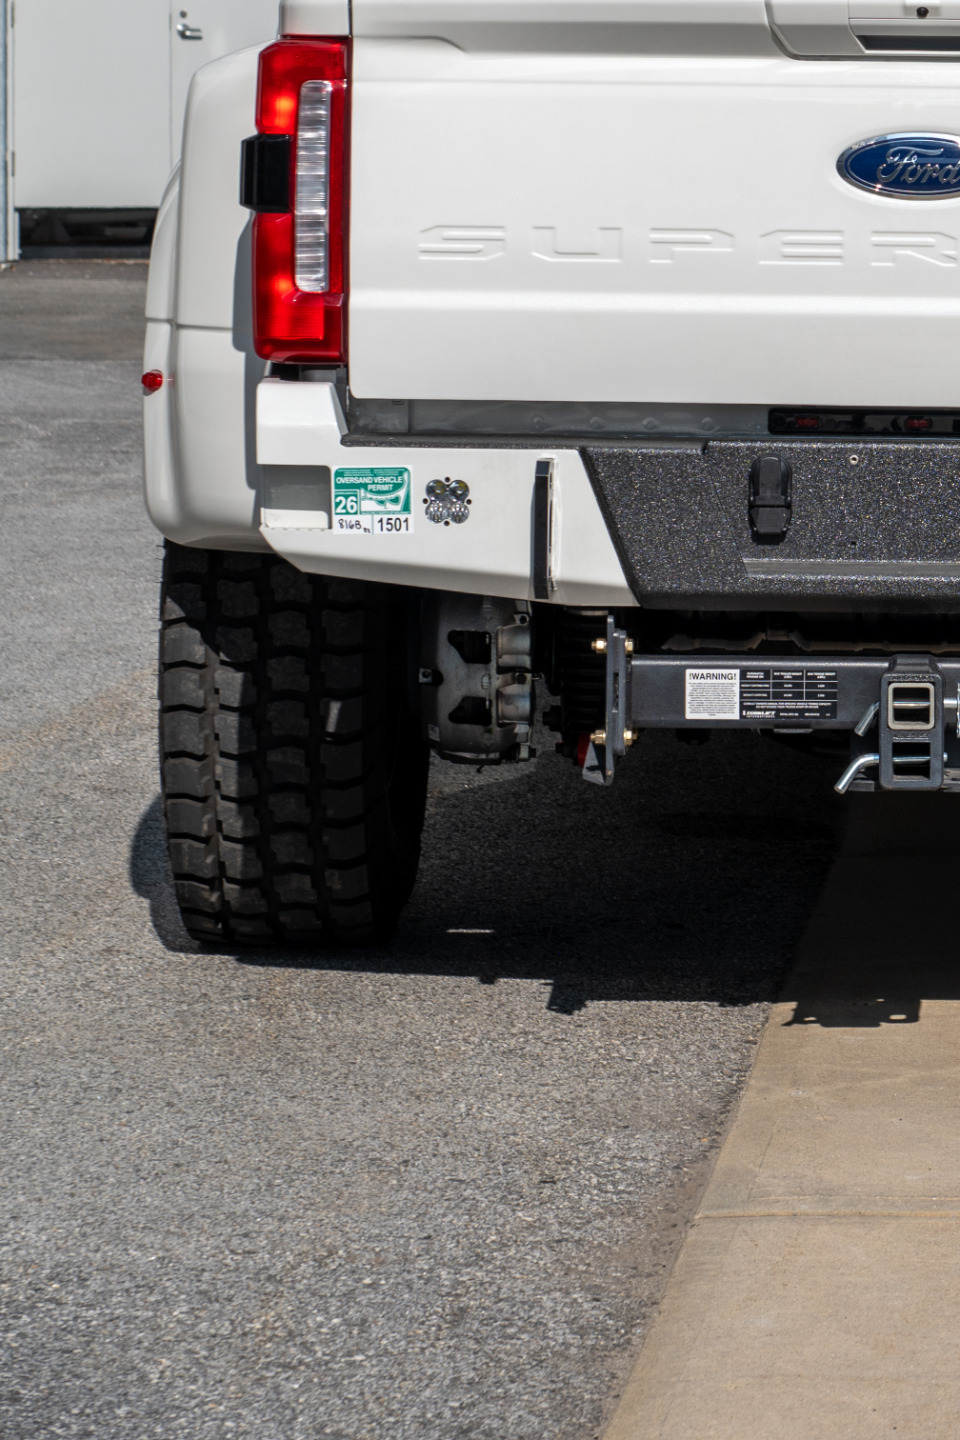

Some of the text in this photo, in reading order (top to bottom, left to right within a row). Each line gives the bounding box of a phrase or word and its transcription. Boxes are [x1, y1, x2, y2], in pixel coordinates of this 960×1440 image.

[417, 224, 959, 267] SUPER
[335, 476, 403, 484] OVERSAND VEHICLE
[335, 496, 358, 514] 26
[377, 517, 409, 532] 1501
[688, 672, 737, 681] !WARNING!
